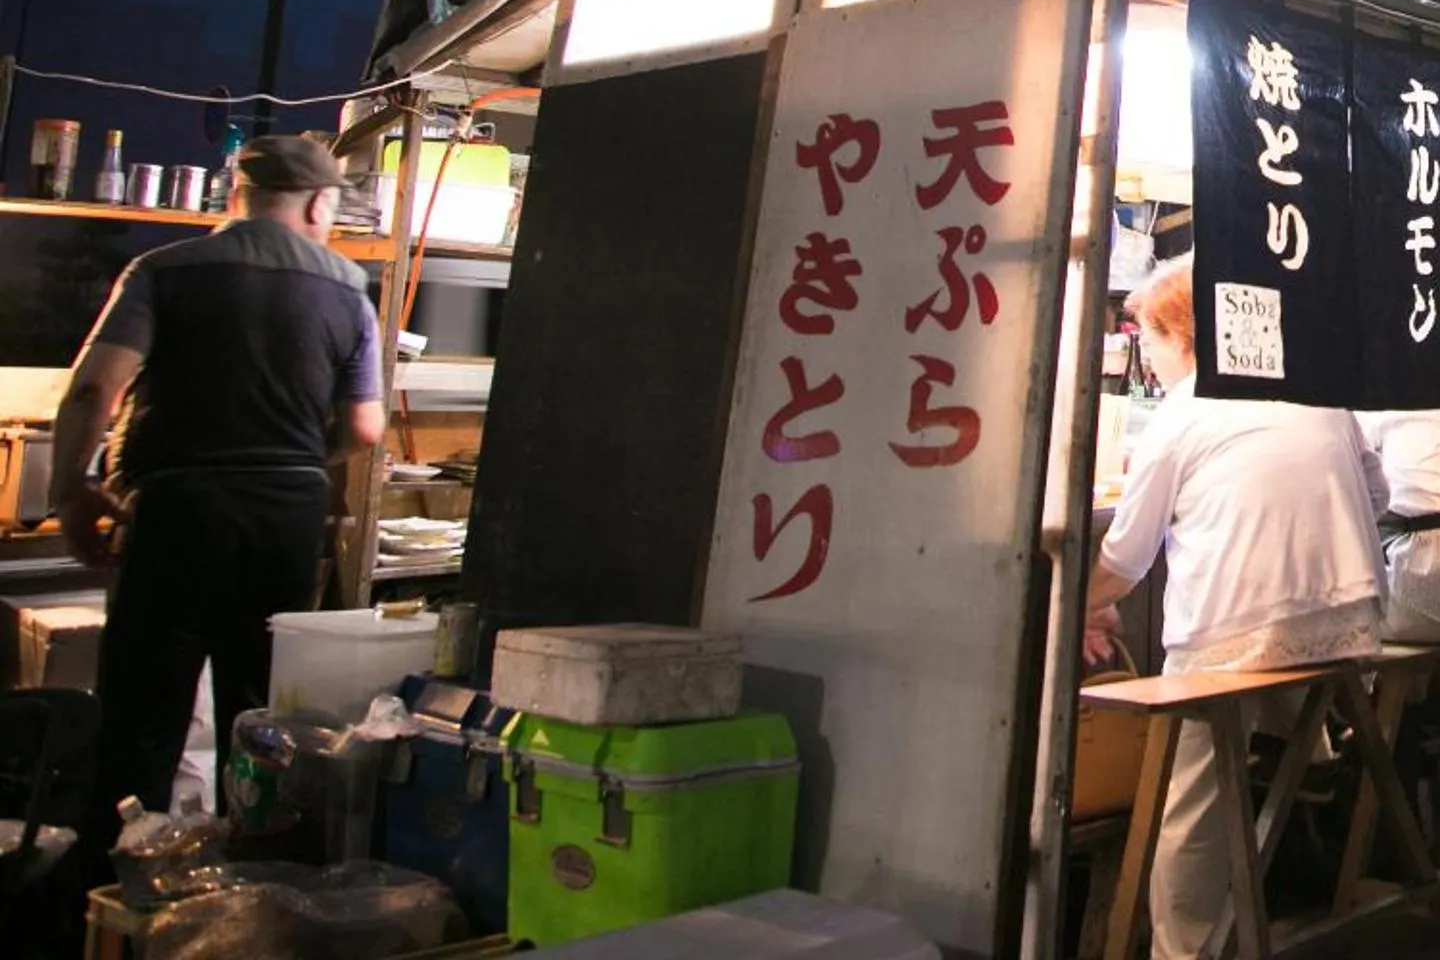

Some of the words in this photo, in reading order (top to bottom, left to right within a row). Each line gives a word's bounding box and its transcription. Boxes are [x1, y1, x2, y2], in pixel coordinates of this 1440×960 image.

[888, 100, 1015, 469] 天ぷら
[1247, 35, 1310, 271] 焼とり
[1400, 78, 1440, 343] ホルモン
[747, 113, 881, 603] やきとり
[1226, 344, 1277, 372] Soda
